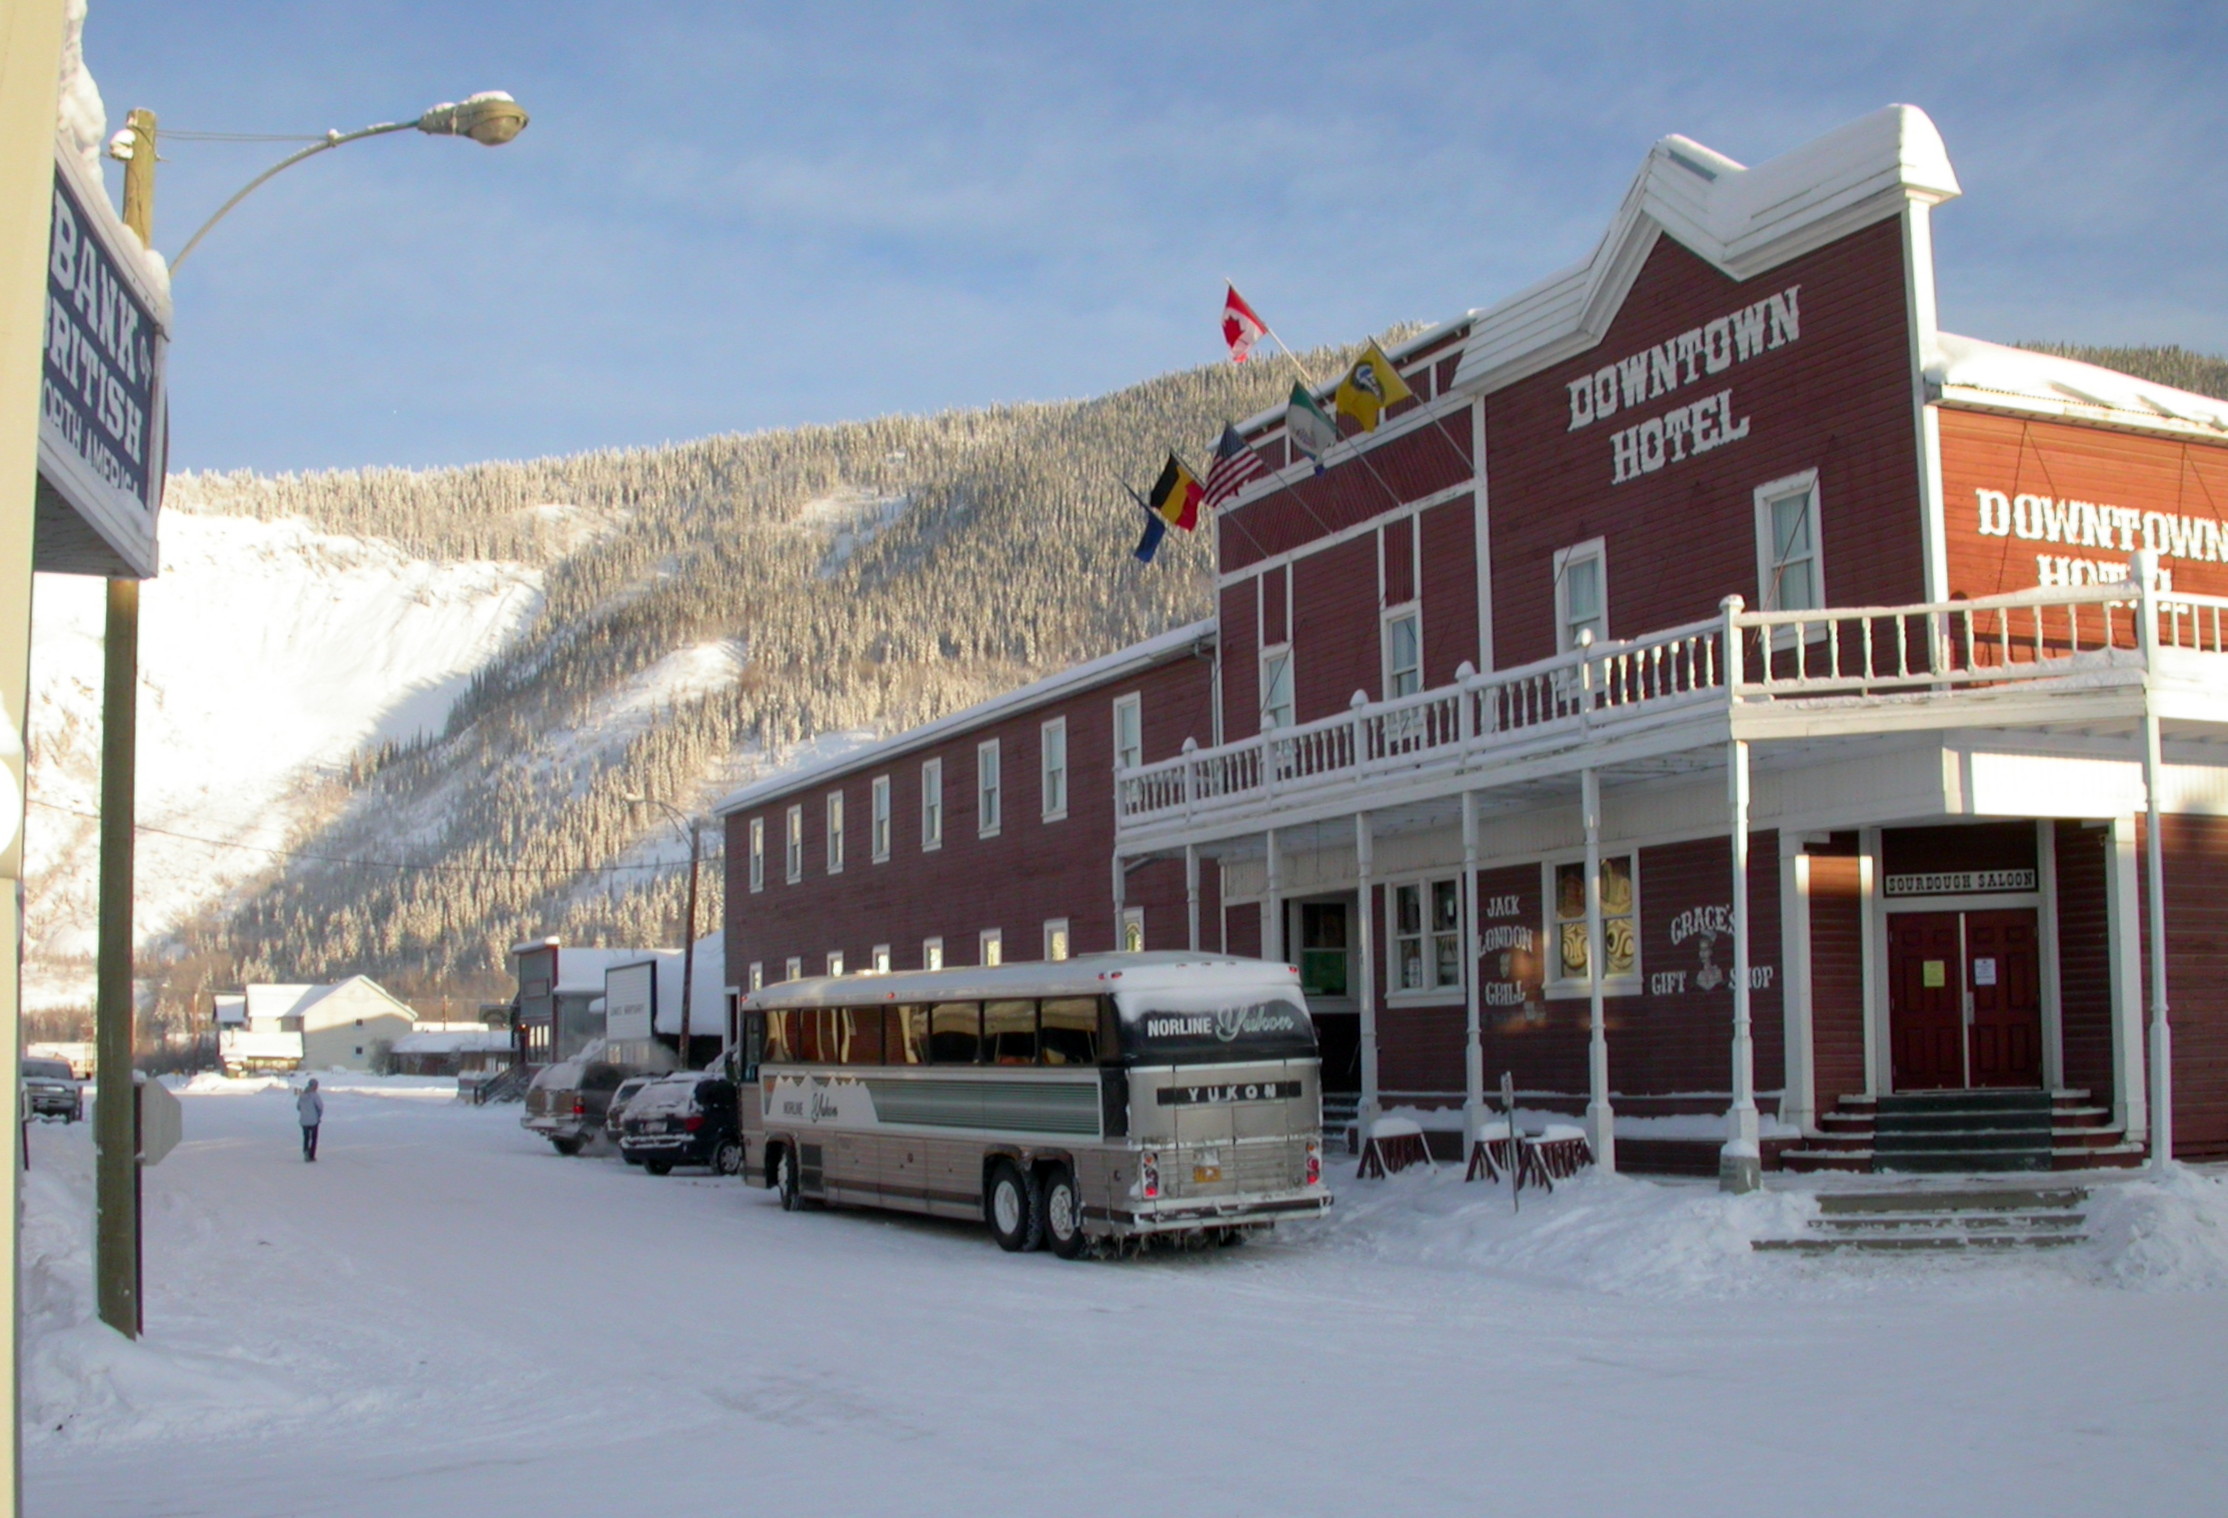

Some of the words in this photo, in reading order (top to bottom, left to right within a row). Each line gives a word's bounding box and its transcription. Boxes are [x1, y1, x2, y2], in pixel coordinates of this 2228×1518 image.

[51, 189, 138, 384] BANK
[1565, 284, 1801, 432] DOWNTOWN
[43, 377, 82, 457] ORTH
[1610, 388, 1750, 485] HOTEL
[1975, 488, 2228, 563] DOWNTOWN
[2036, 554, 2189, 614] HOTL
[1486, 895, 1520, 917] JACK
[1888, 875, 1971, 892] SOURDOUGH
[1978, 871, 2033, 888] SALOON
[1485, 980, 1526, 1006] GRILL
[1651, 970, 1687, 995] GIFT
[1728, 966, 1773, 990] SOP
[1147, 1016, 1212, 1038] NORLINE
[1215, 1003, 1295, 1042] Yukon
[1188, 1083, 1277, 1102] YUKON
